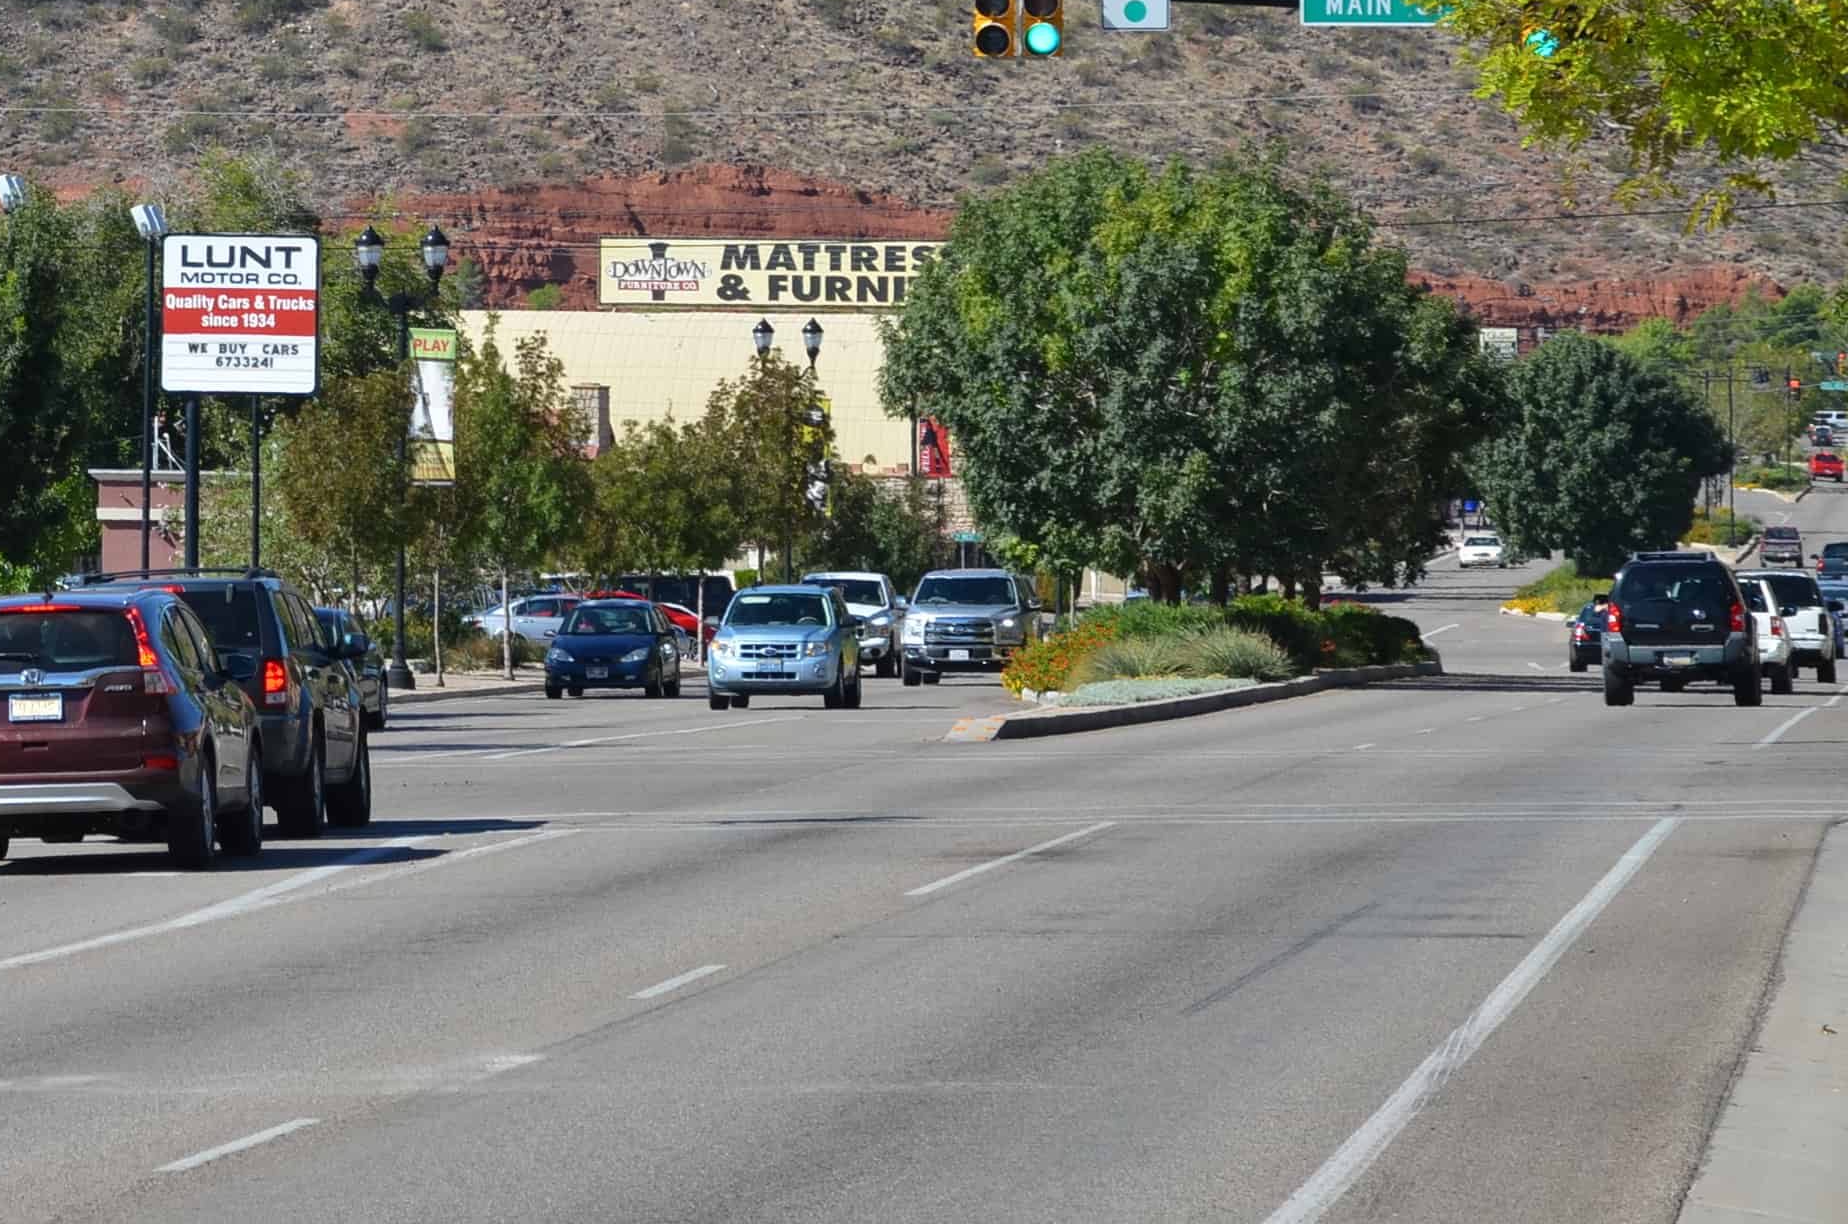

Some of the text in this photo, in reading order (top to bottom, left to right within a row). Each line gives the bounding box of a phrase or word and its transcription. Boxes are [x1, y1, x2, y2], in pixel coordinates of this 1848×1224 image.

[181, 245, 302, 269] LUNT
[719, 244, 953, 273] MATTRES
[611, 258, 706, 280] DOWNTOWN
[180, 272, 302, 285] MOTOR CO.
[619, 281, 680, 289] FURNITURE
[716, 274, 920, 302] & FURNI
[165, 294, 315, 311] Quality Cars & Trucks
[201, 312, 276, 327] since 1934
[188, 342, 300, 355] WE BUY CARS
[413, 339, 450, 352] PLAY
